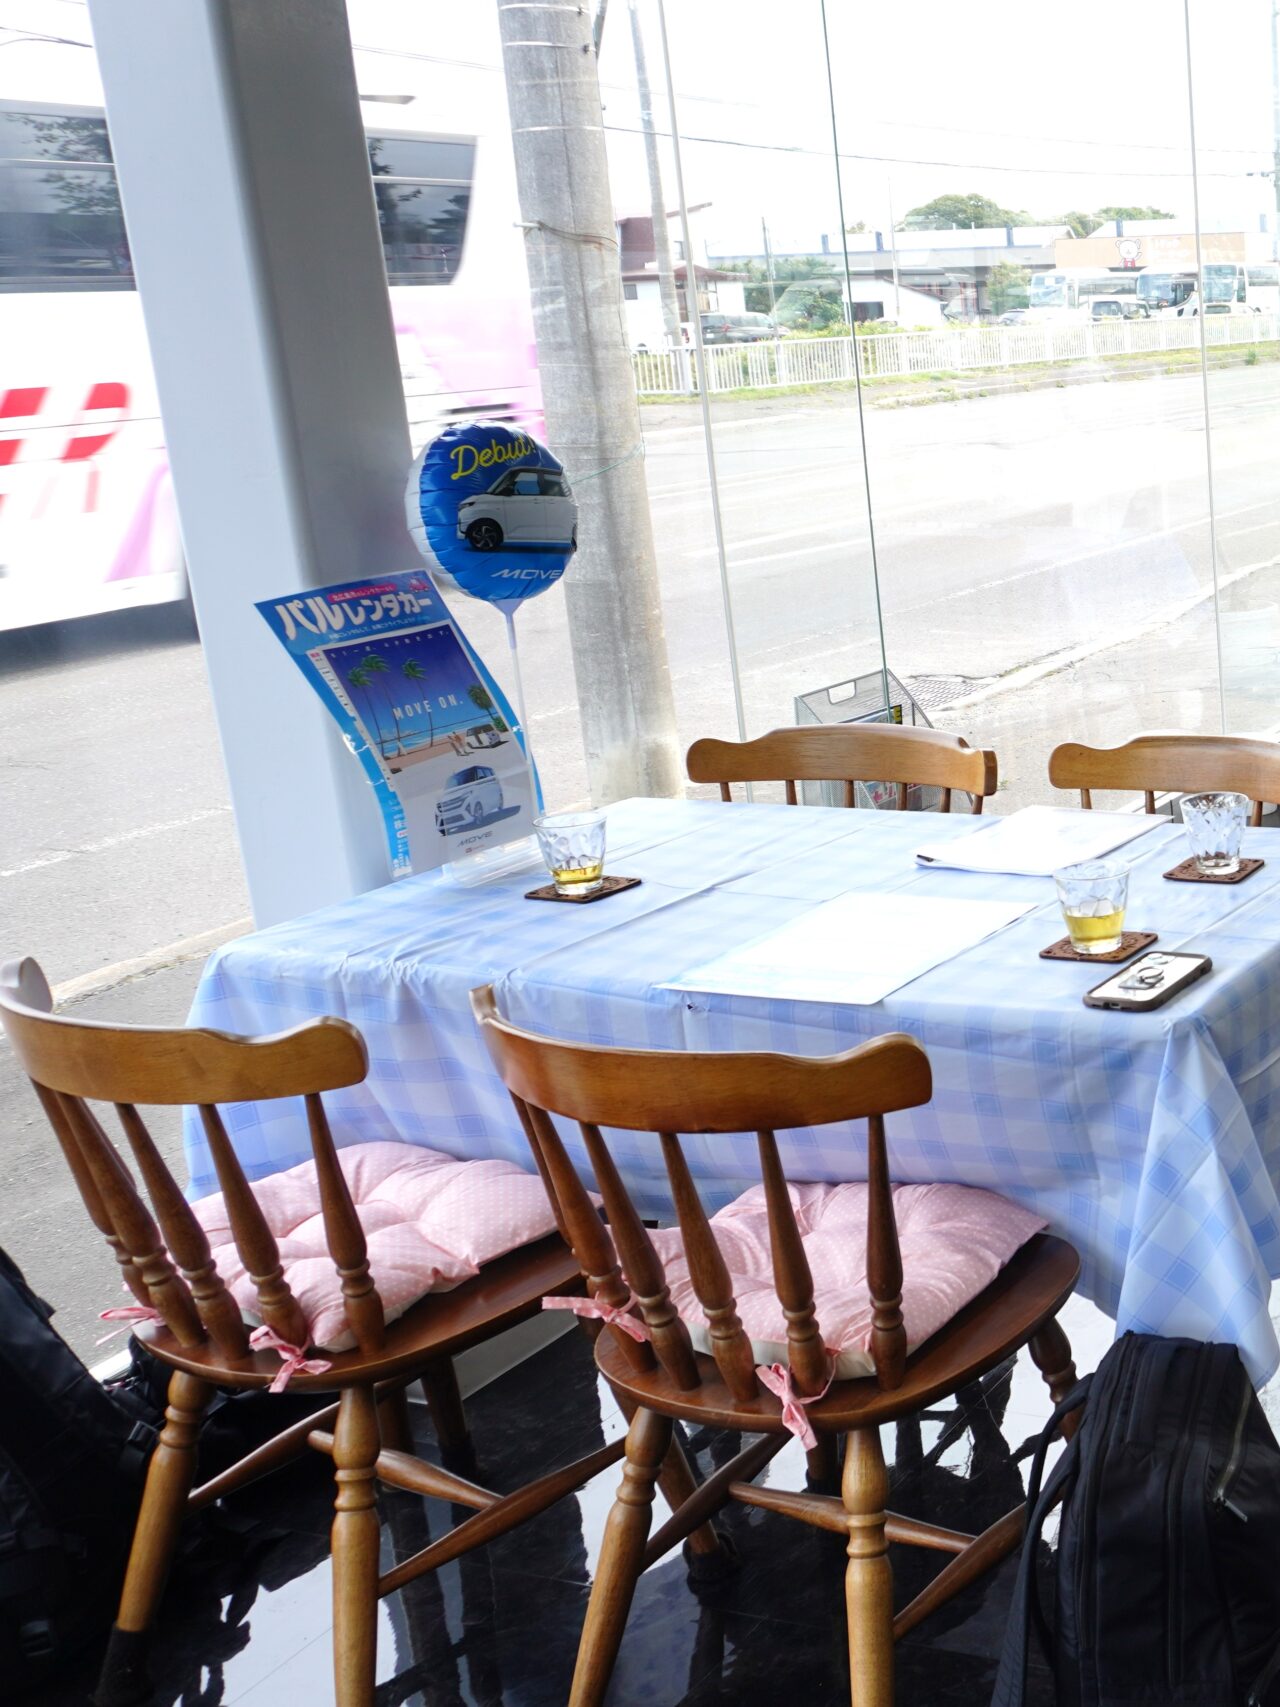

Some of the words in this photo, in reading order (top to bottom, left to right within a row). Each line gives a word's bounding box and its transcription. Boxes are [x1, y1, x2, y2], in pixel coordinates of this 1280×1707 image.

[450, 434, 537, 480] Debut!
[491, 569, 563, 580] MOVE
[392, 699, 432, 720] MOVE
[438, 694, 464, 709] ON.
